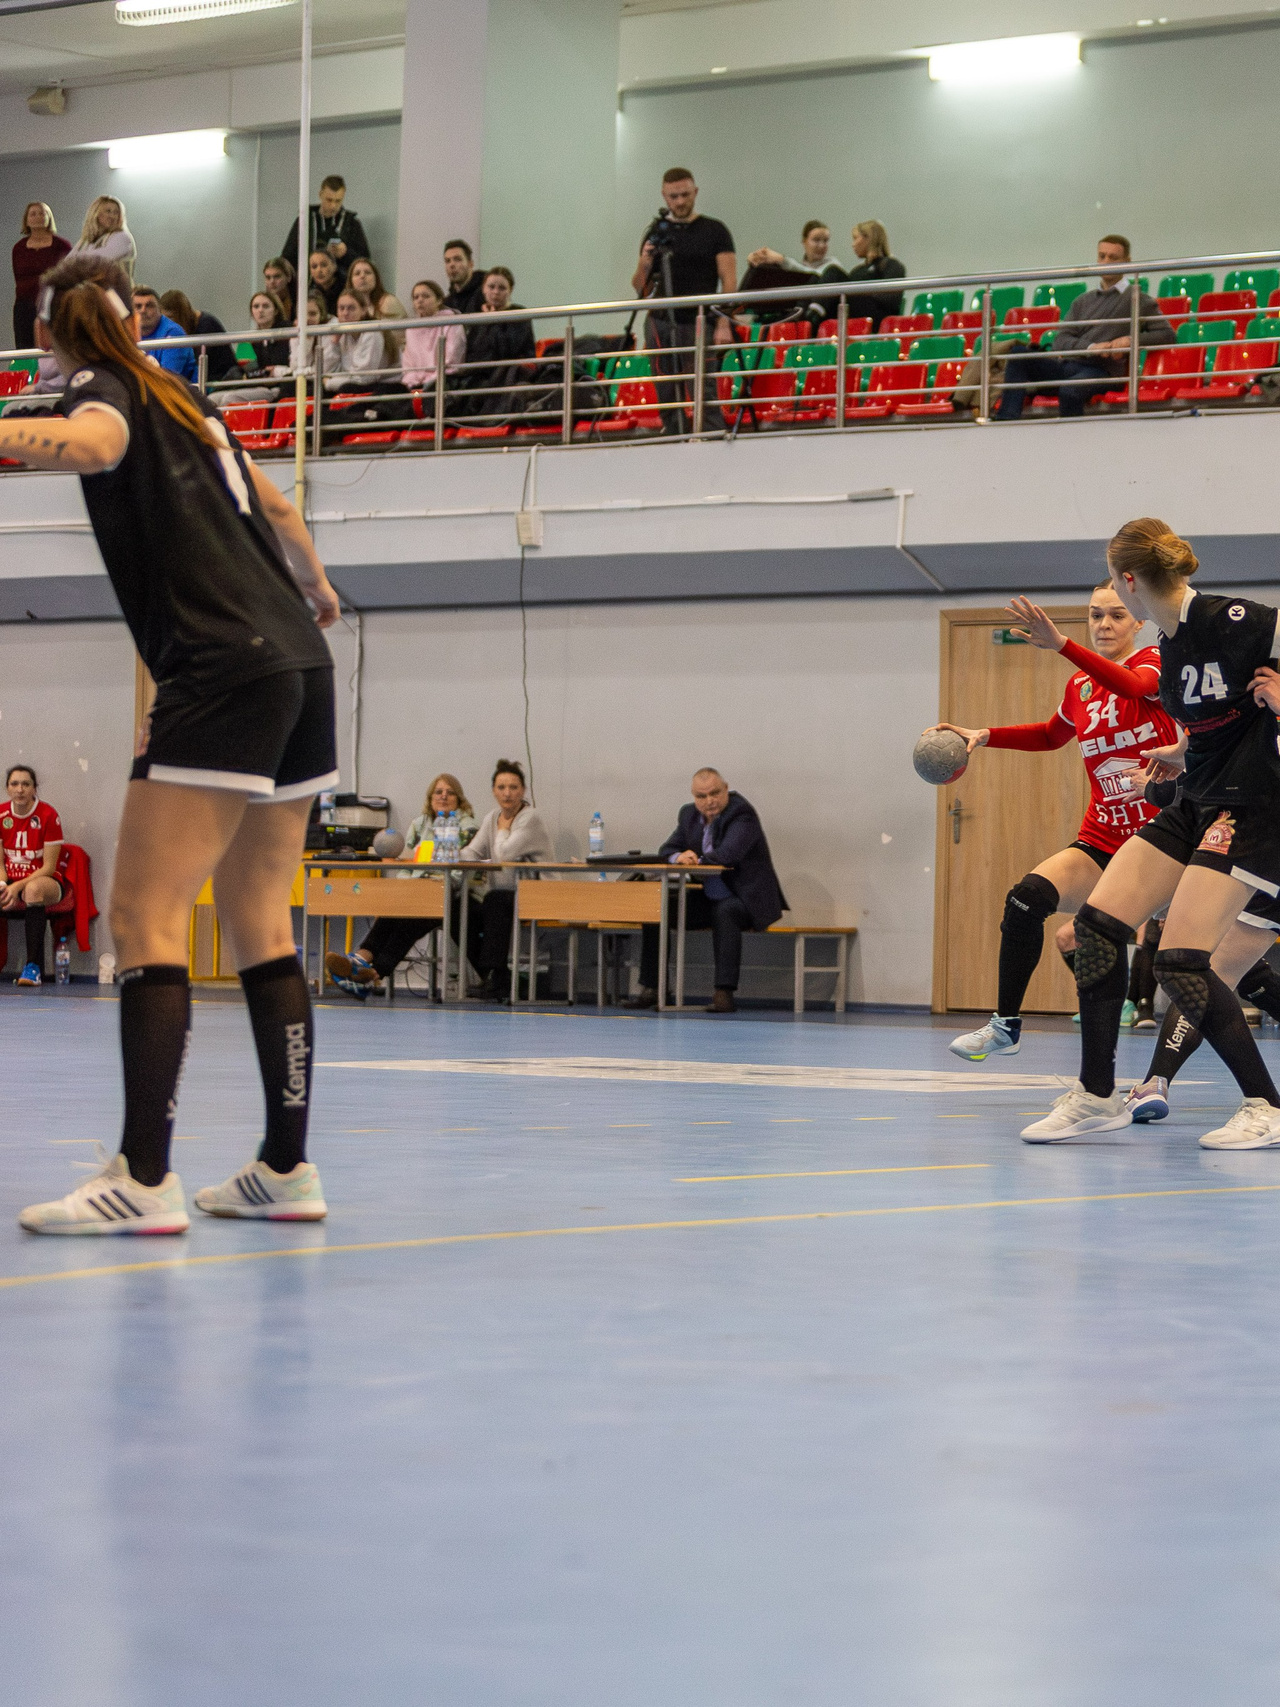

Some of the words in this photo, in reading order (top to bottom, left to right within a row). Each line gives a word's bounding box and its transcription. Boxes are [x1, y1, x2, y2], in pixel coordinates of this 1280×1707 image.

[1181, 661, 1228, 704] 24
[1083, 693, 1119, 734] 34
[1120, 827, 1138, 836] 192
[1165, 1014, 1195, 1053] Kemp
[283, 1022, 311, 1108] Kempa
